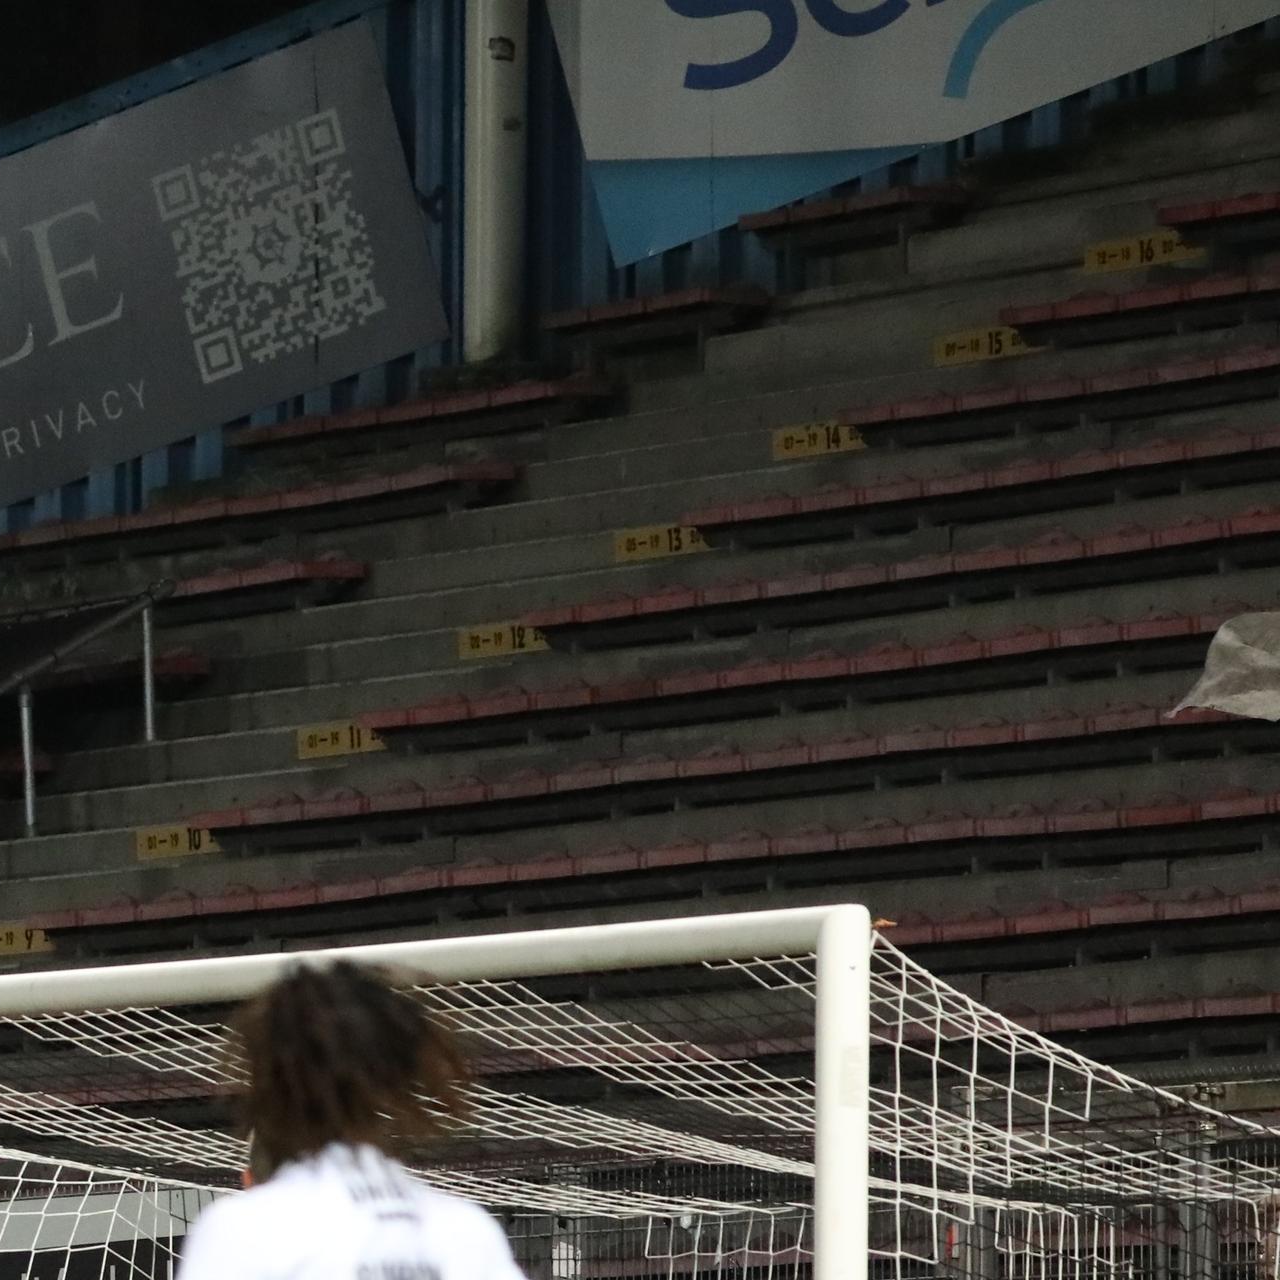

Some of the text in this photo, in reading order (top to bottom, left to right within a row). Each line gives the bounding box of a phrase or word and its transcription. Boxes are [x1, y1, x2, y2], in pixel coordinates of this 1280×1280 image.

[988, 331, 1002, 354] 15
[825, 426, 841, 450] 14
[667, 528, 682, 552] 13
[512, 625, 526, 649] 12
[350, 725, 361, 749] 11
[188, 827, 201, 850] 10
[25, 929, 34, 950] 9
